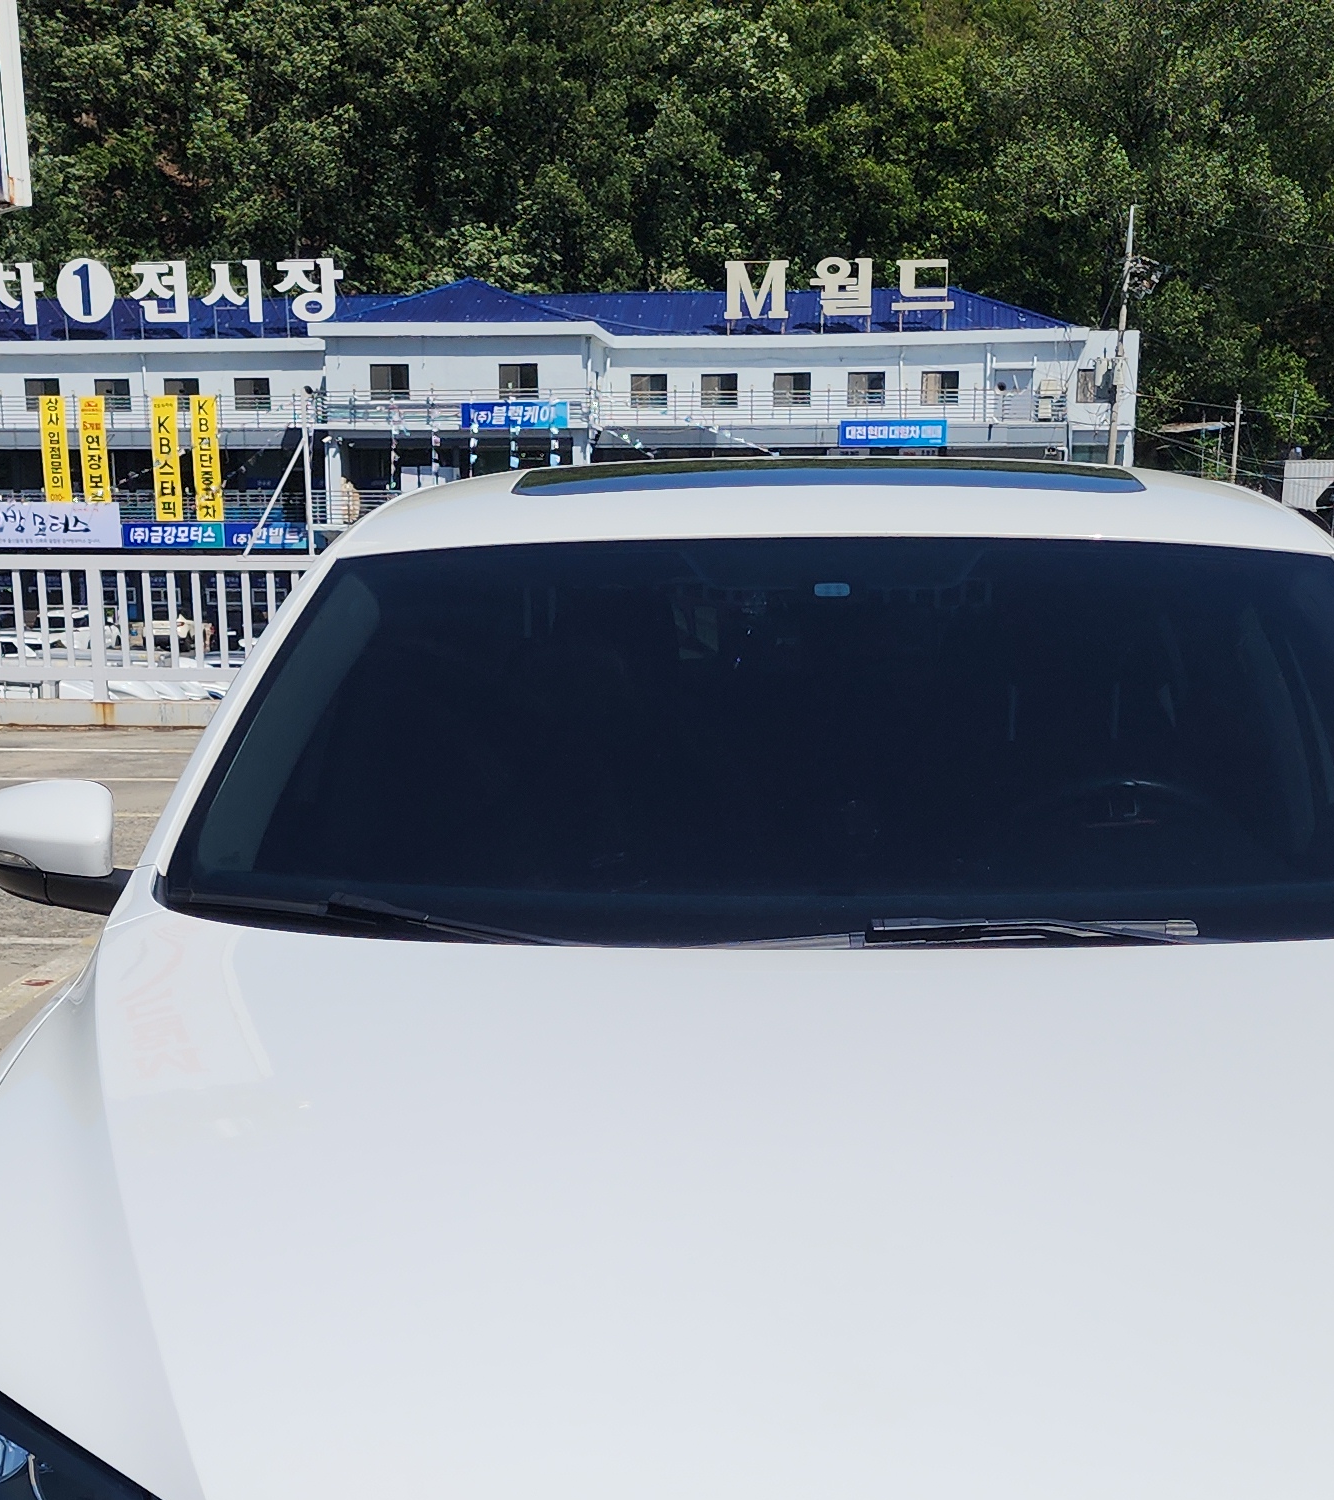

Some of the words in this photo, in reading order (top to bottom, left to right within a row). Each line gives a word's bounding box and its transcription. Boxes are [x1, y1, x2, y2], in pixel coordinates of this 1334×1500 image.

[129, 258, 344, 323] 전시장
[724, 257, 955, 320] M월드
[46, 398, 60, 426] 상사
[48, 431, 64, 489] 입점문의
[130, 526, 216, 545] (주)금강모터스
